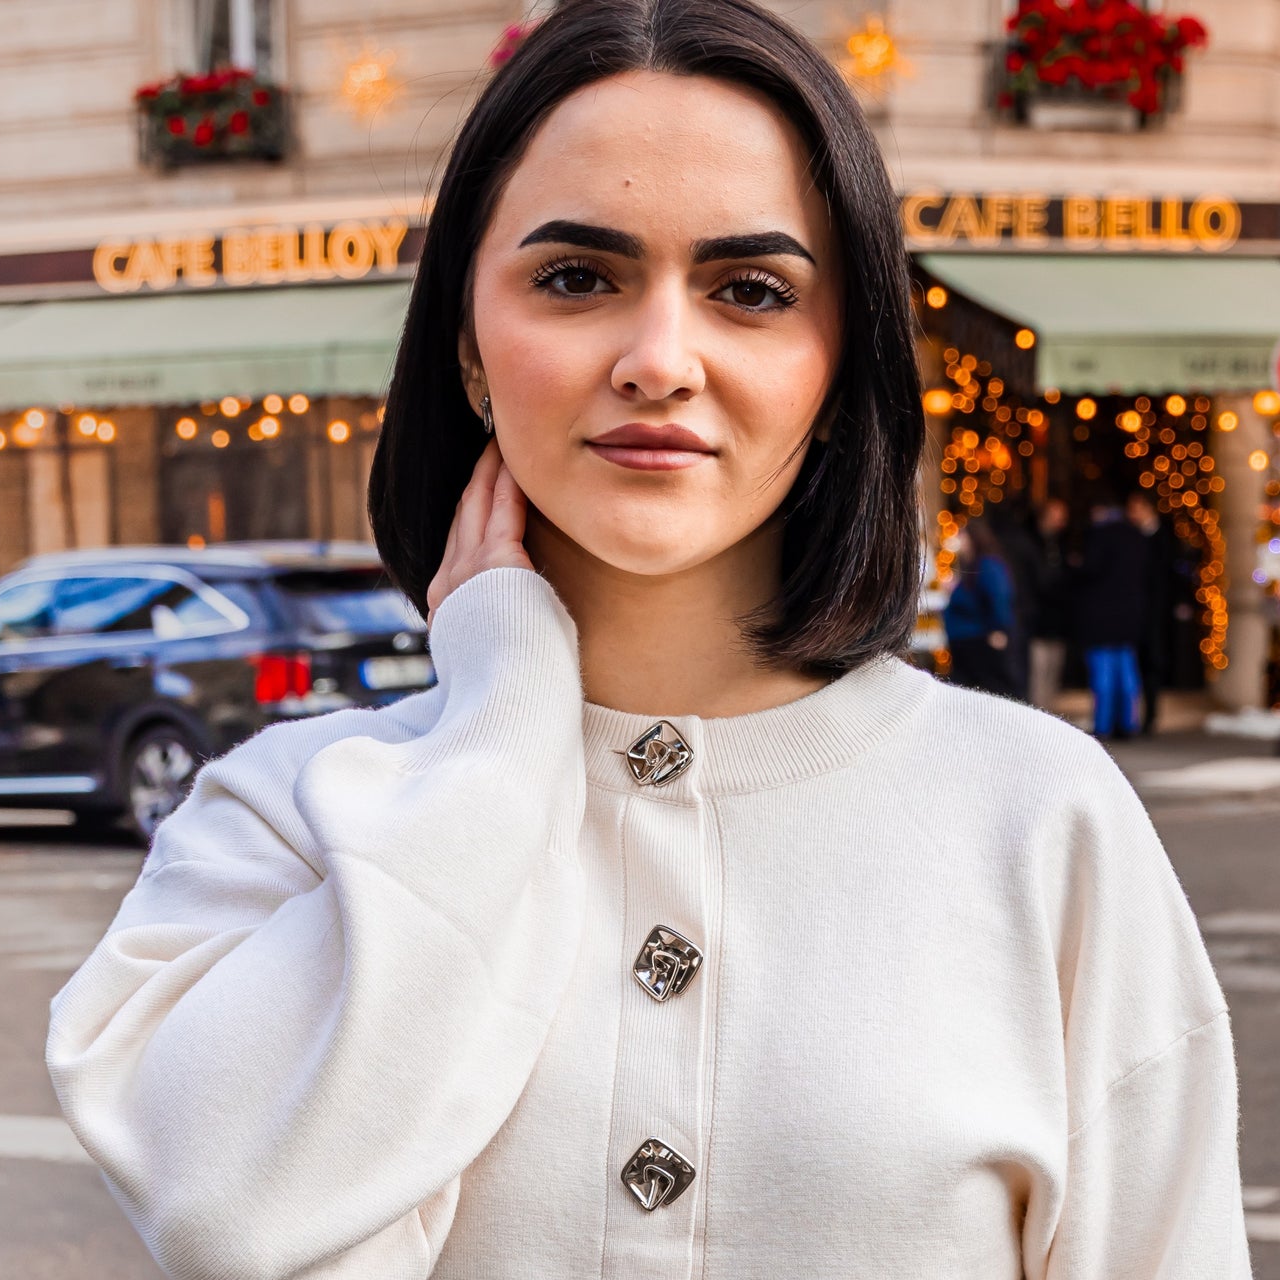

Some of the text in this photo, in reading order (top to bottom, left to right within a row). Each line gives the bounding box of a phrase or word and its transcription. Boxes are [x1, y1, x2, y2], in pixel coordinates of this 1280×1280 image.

[901, 188, 1242, 252] CAFE BELLO
[93, 220, 409, 292] CAFE BELLOY
